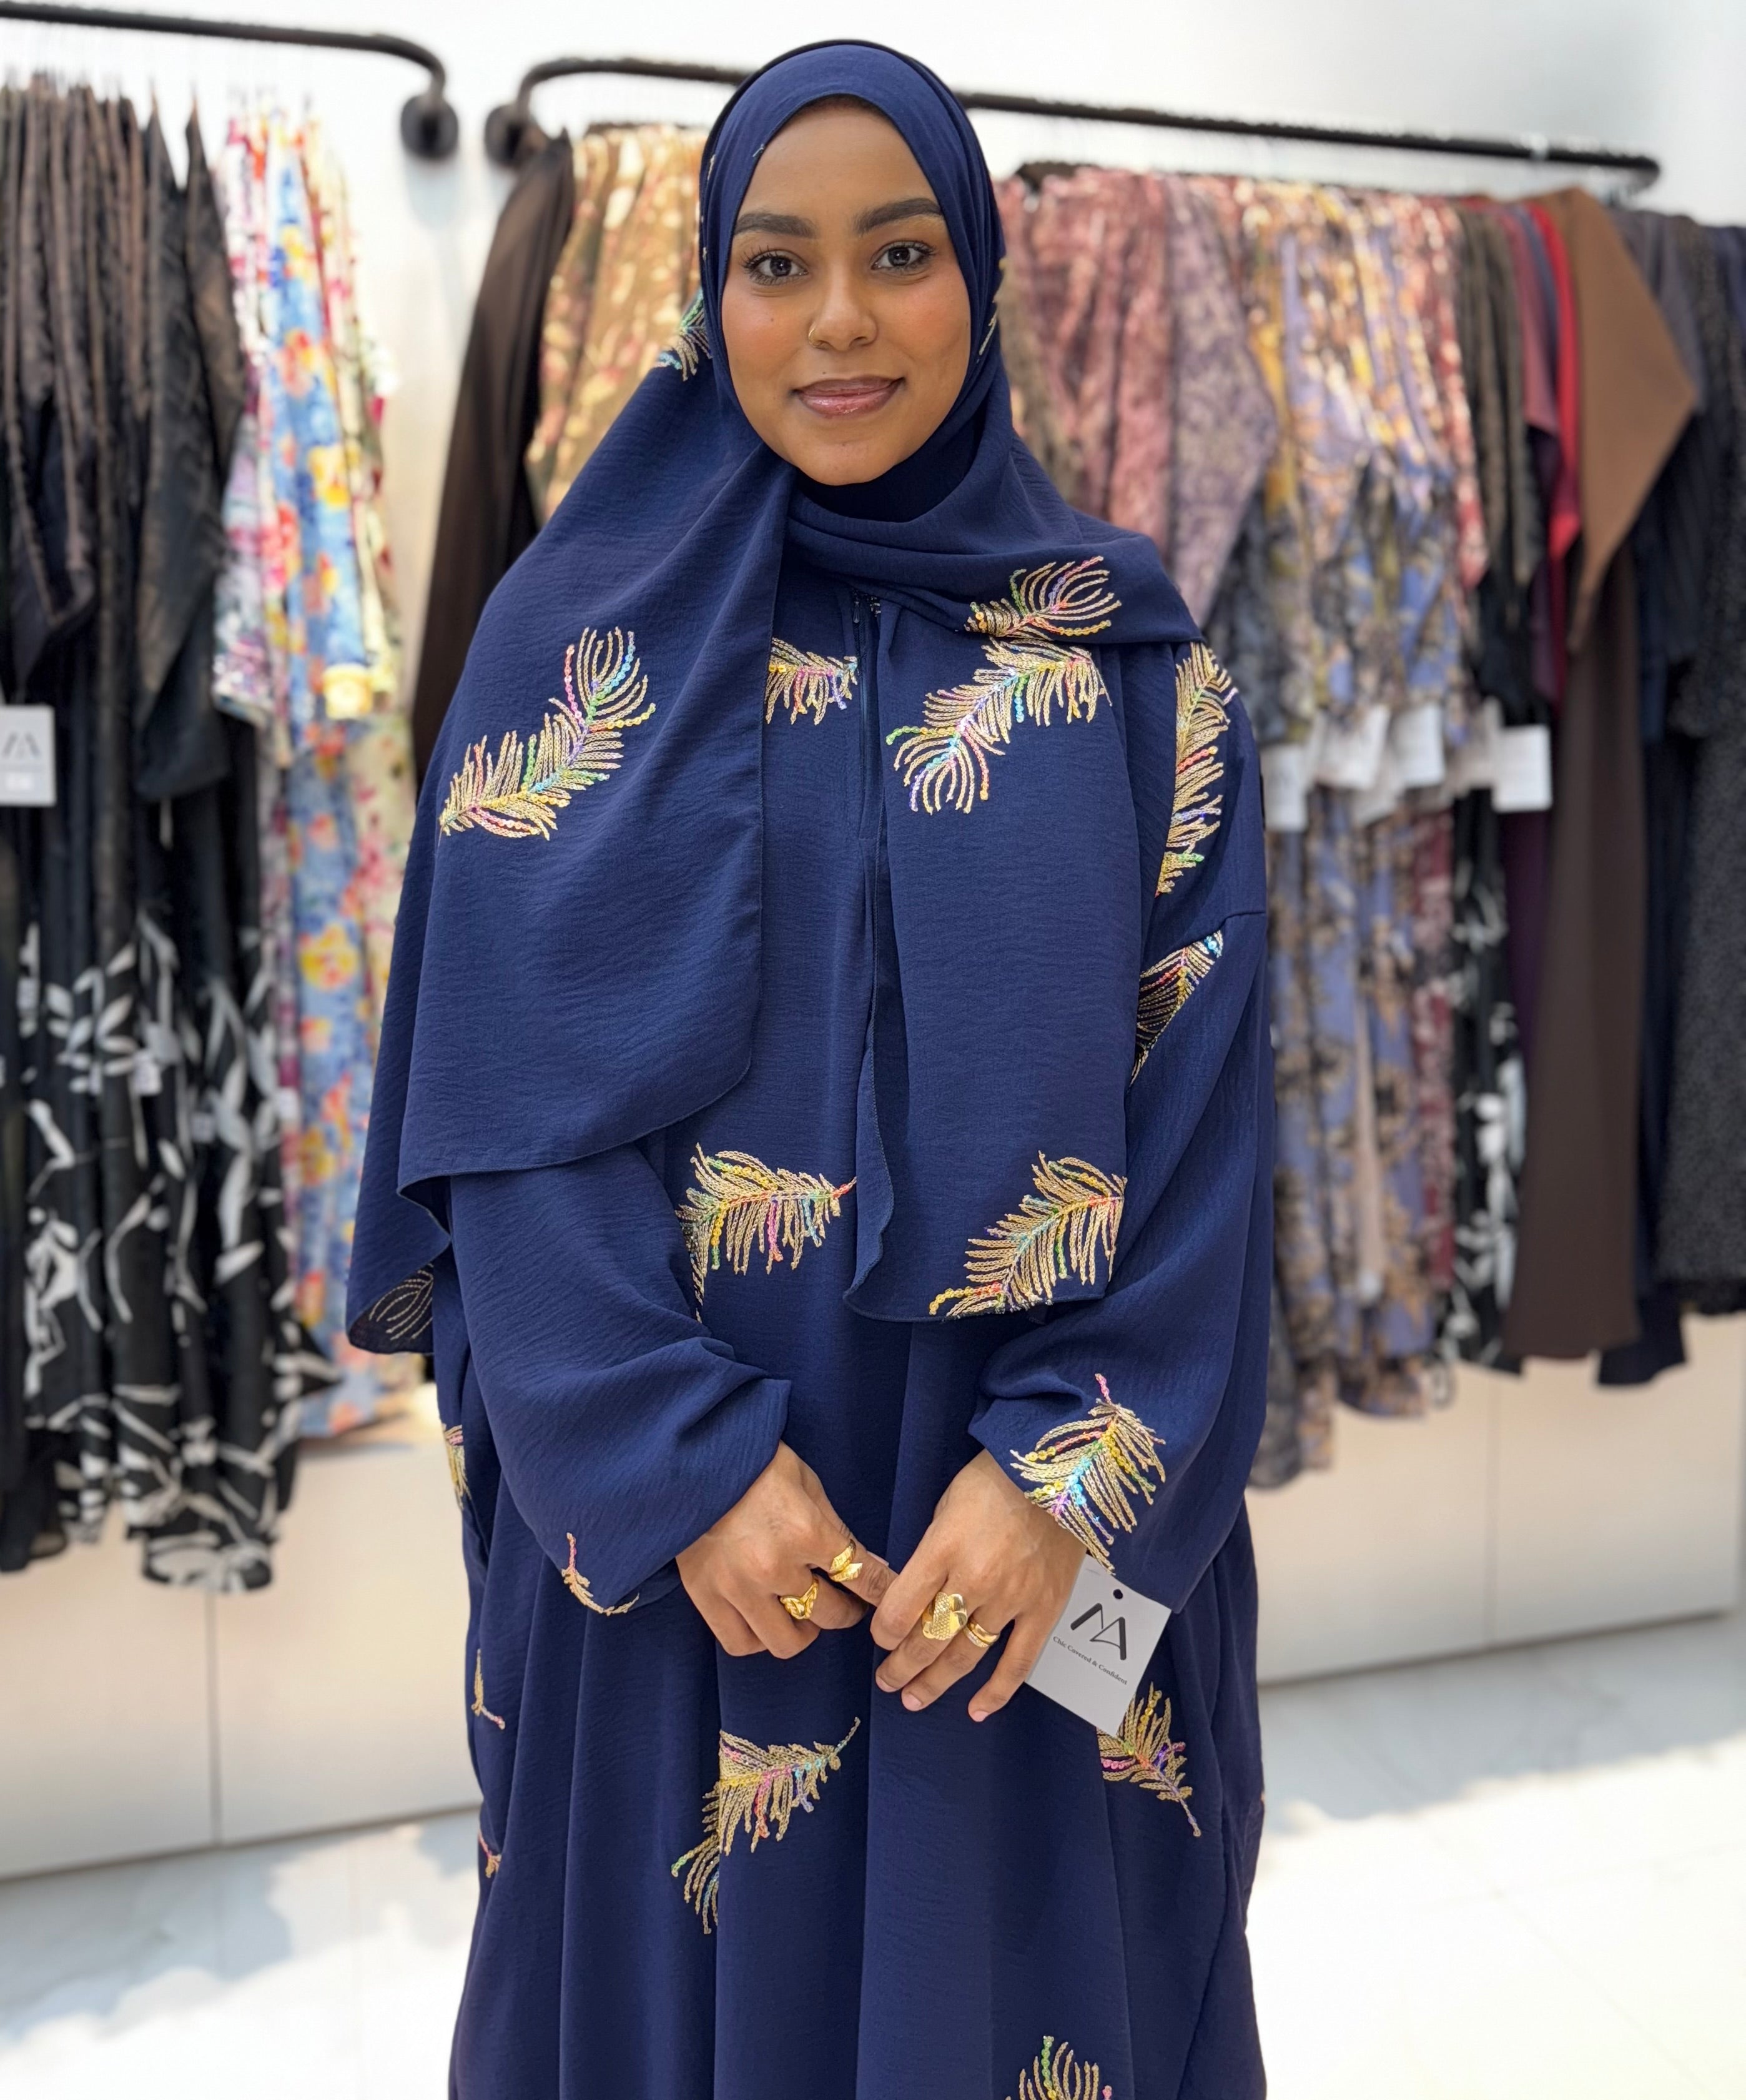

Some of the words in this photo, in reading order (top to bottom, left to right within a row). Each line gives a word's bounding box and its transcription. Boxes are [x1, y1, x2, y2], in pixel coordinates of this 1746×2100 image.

[1053, 1636, 1067, 1648] Chic
[1067, 1645, 1092, 1663] Covered
[1092, 1659, 1098, 1667] &
[1098, 1664, 1128, 1685] Confident
